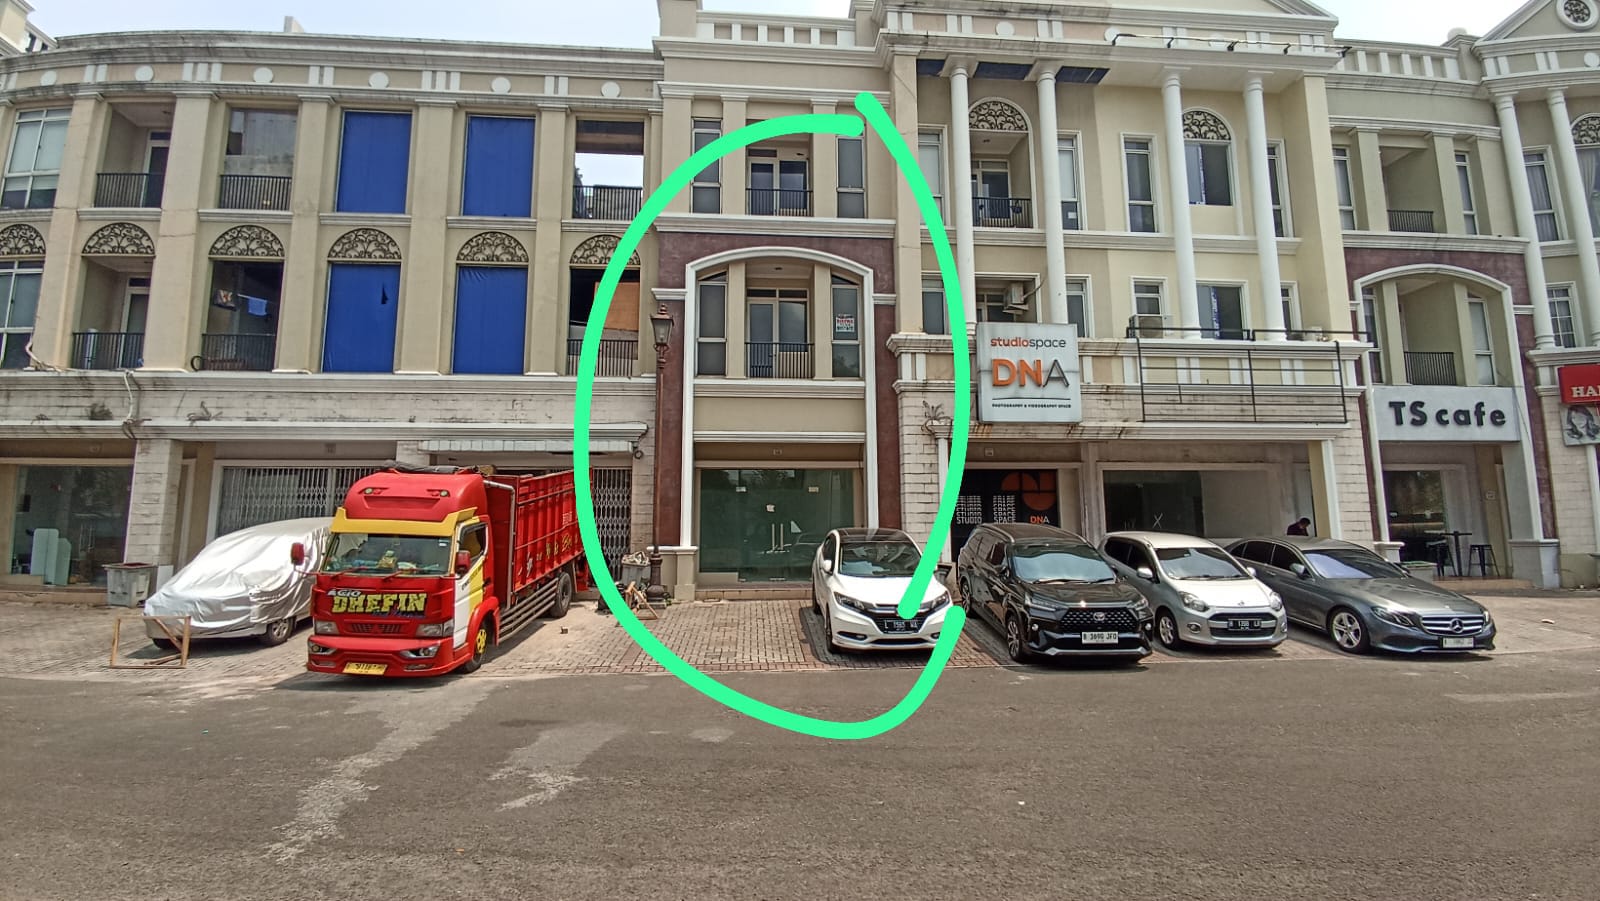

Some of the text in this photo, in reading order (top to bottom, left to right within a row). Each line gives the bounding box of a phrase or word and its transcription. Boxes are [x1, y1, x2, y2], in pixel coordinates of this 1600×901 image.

[990, 337, 1067, 350] studiospace
[992, 359, 1070, 388] DNA
[1389, 401, 1506, 426] TS cafe
[956, 516, 1016, 525] STUDIO SPACE
